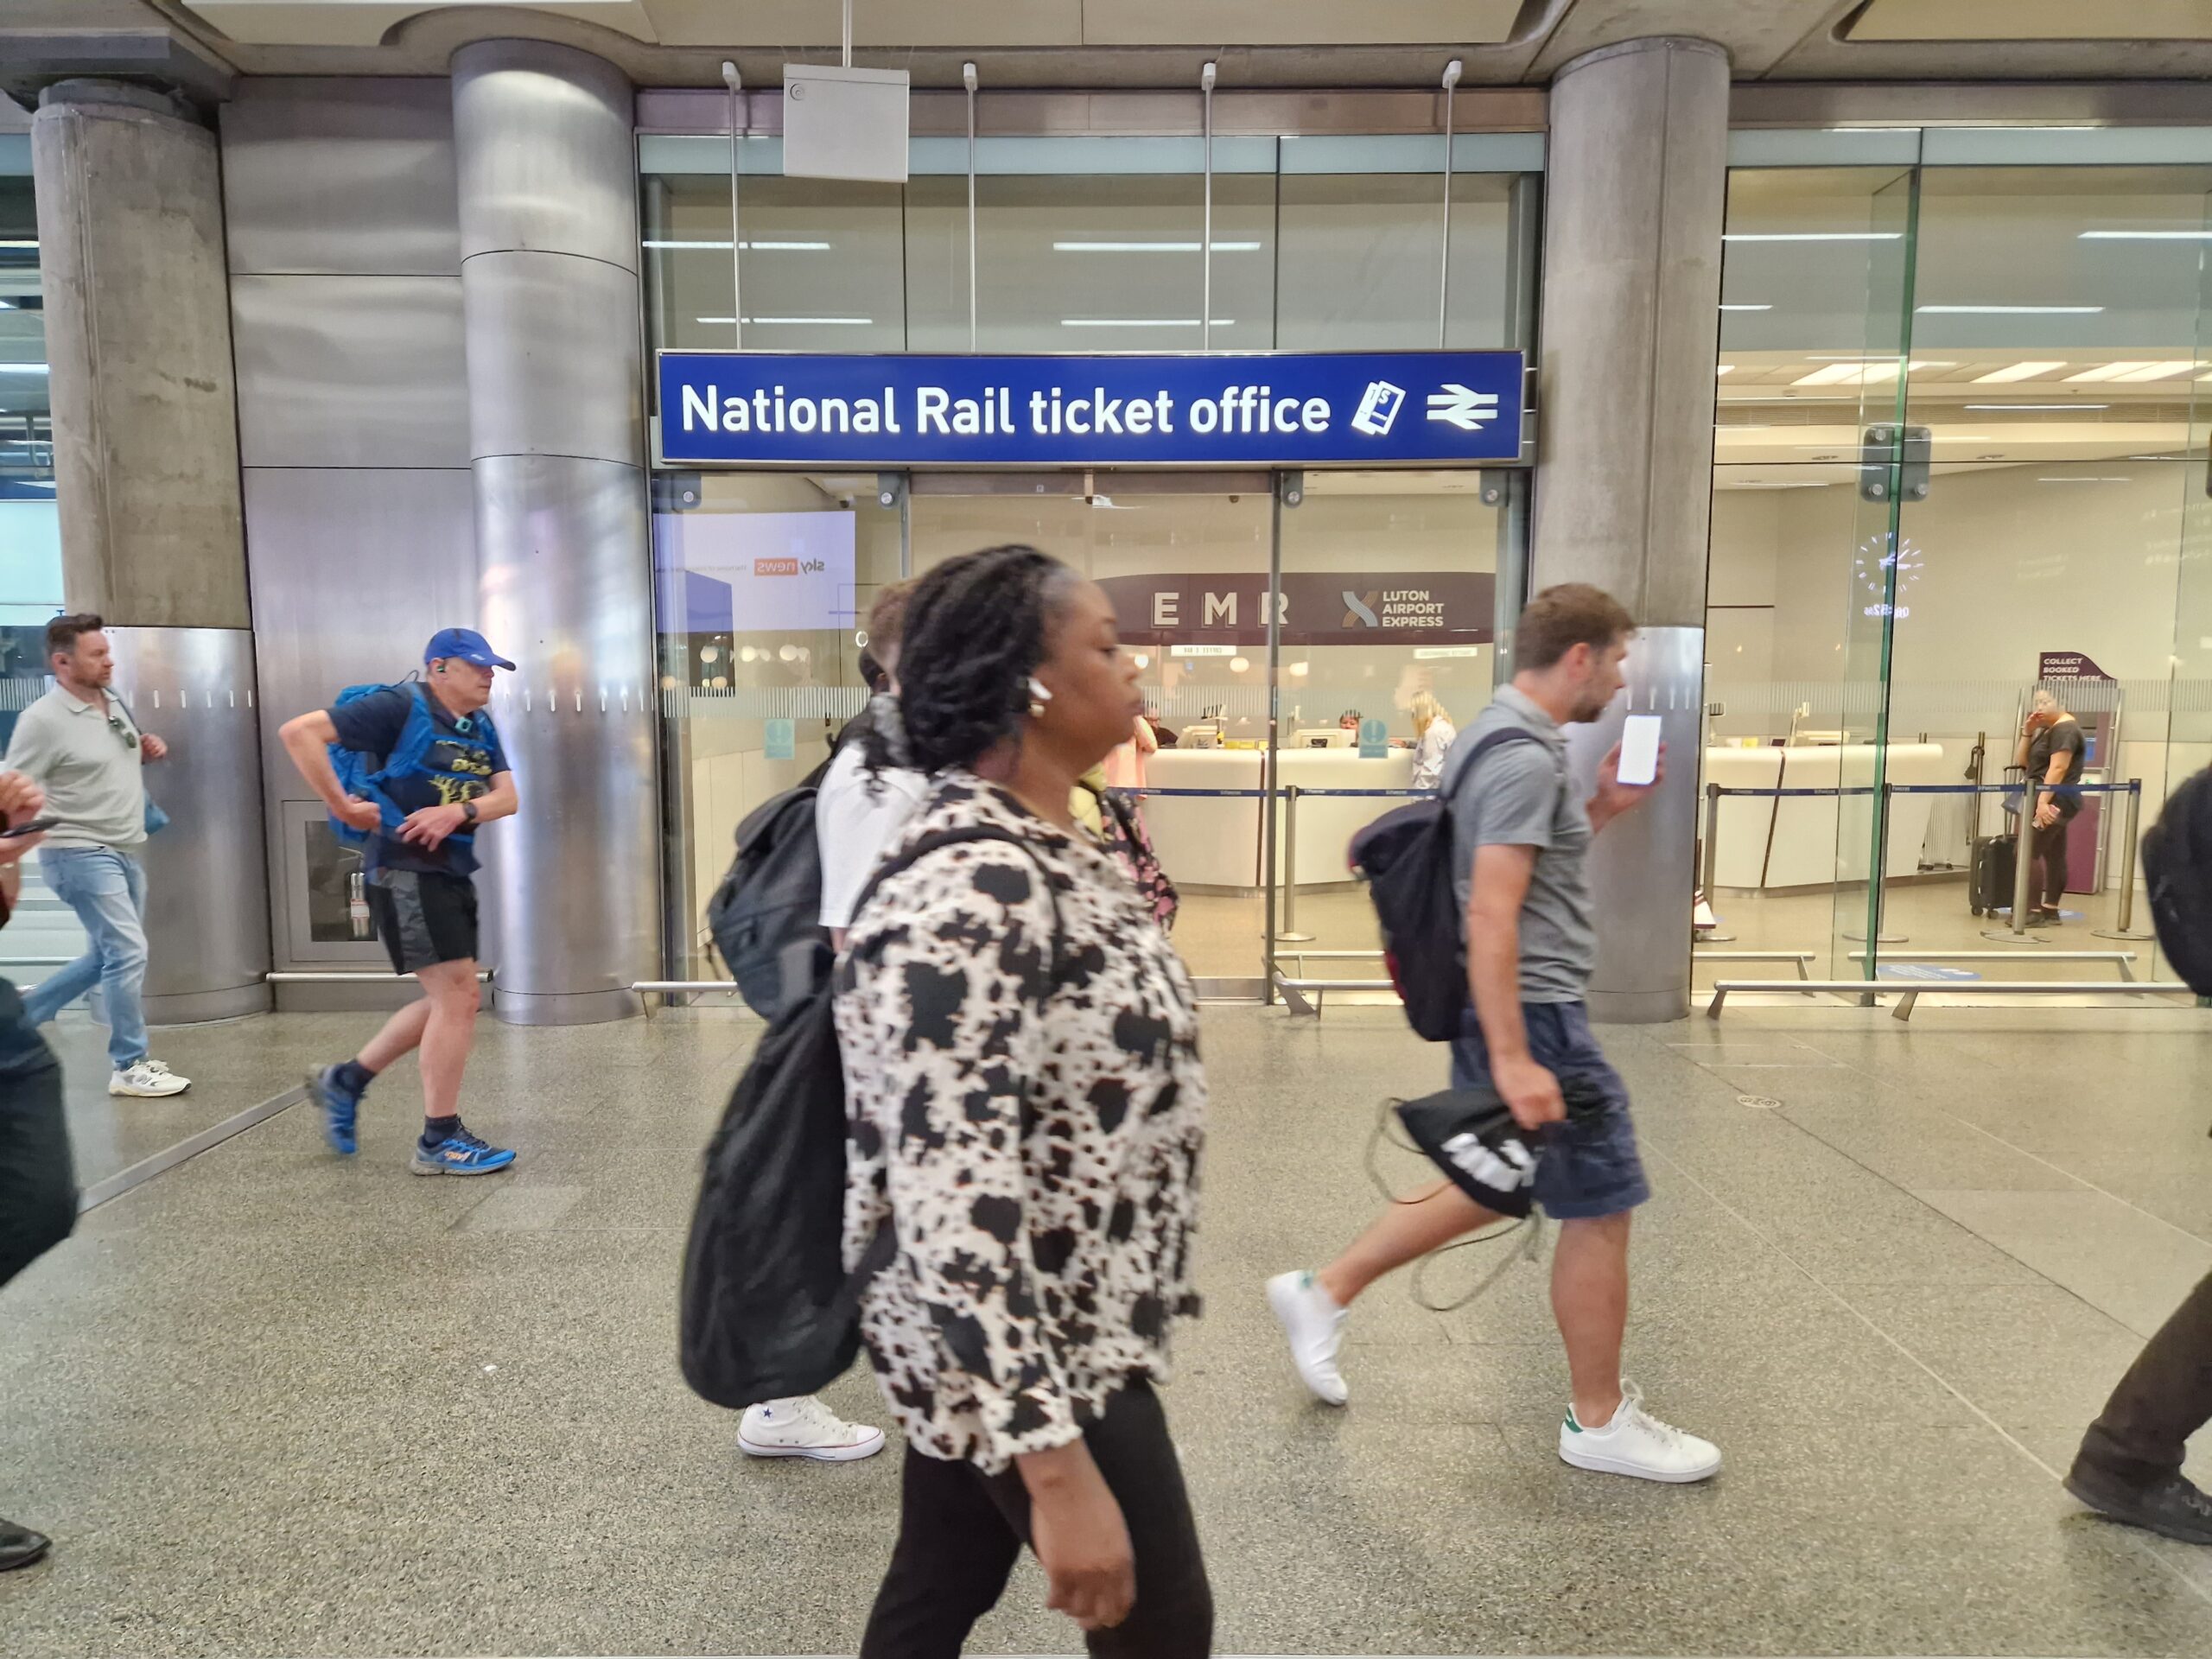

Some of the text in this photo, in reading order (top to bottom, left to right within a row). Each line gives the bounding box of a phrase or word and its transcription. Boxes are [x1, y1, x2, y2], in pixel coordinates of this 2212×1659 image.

[681, 385, 1332, 434] National Rail ticket office
[1382, 590, 1429, 601] LUTON
[1382, 603, 1445, 614] AIRPORT
[1382, 616, 1444, 627] EXPRESS
